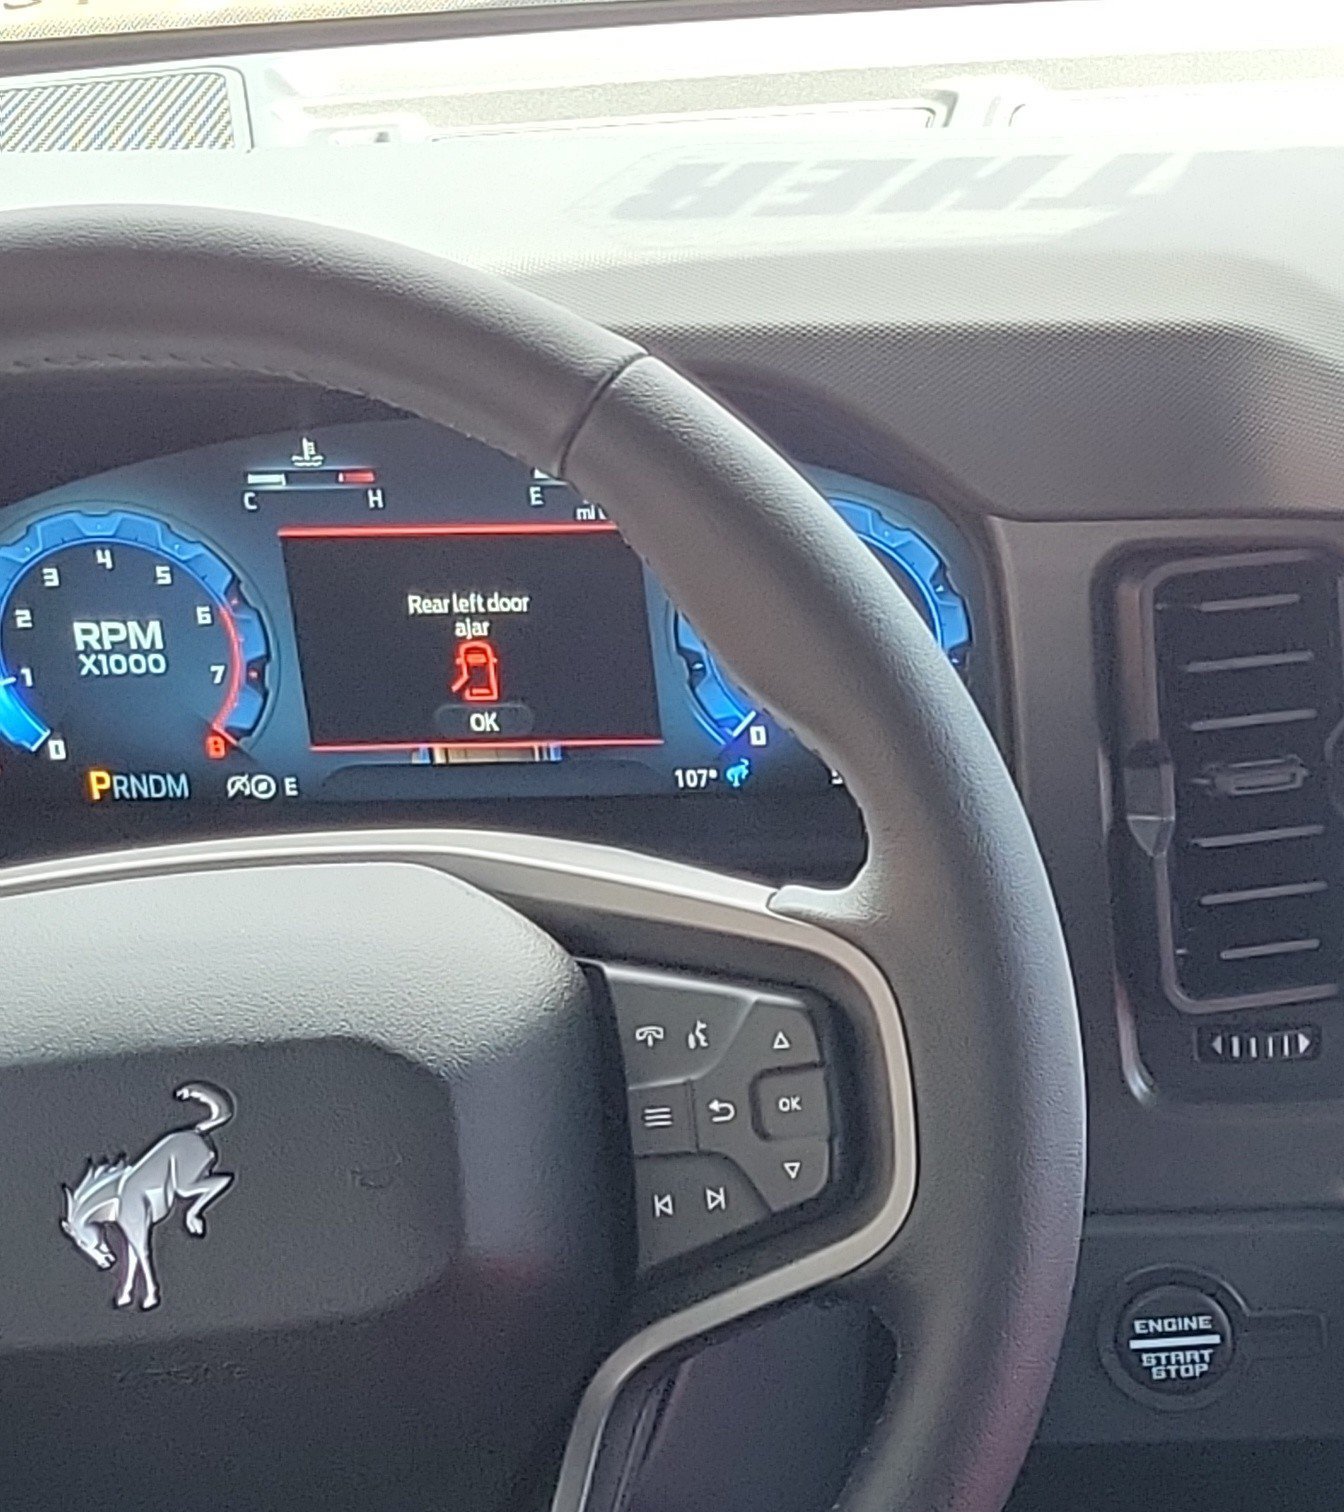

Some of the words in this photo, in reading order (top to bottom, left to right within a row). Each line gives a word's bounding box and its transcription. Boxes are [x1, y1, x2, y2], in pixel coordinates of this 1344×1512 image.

[243, 491, 258, 510] C
[366, 490, 385, 509] H
[529, 486, 544, 506] E
[96, 549, 114, 570] 4
[42, 567, 60, 587] 3
[155, 565, 172, 585] 5
[407, 593, 450, 615] Rear
[451, 591, 486, 614] left
[487, 591, 531, 613] door
[14, 609, 33, 629] 2
[196, 606, 213, 626] 6
[73, 620, 164, 651] RPM
[454, 617, 491, 640] ajar
[79, 653, 167, 676] X1000
[209, 664, 226, 685] 7
[20, 667, 33, 687] 1
[469, 711, 500, 733] OK
[750, 725, 767, 746] 0
[48, 738, 67, 760] 0
[284, 777, 299, 796] E
[673, 768, 718, 789] 107°
[778, 1096, 802, 1112] OK
[1133, 1315, 1213, 1334] ENGINE
[1140, 1349, 1214, 1367] START
[1151, 1363, 1210, 1380] STOP
